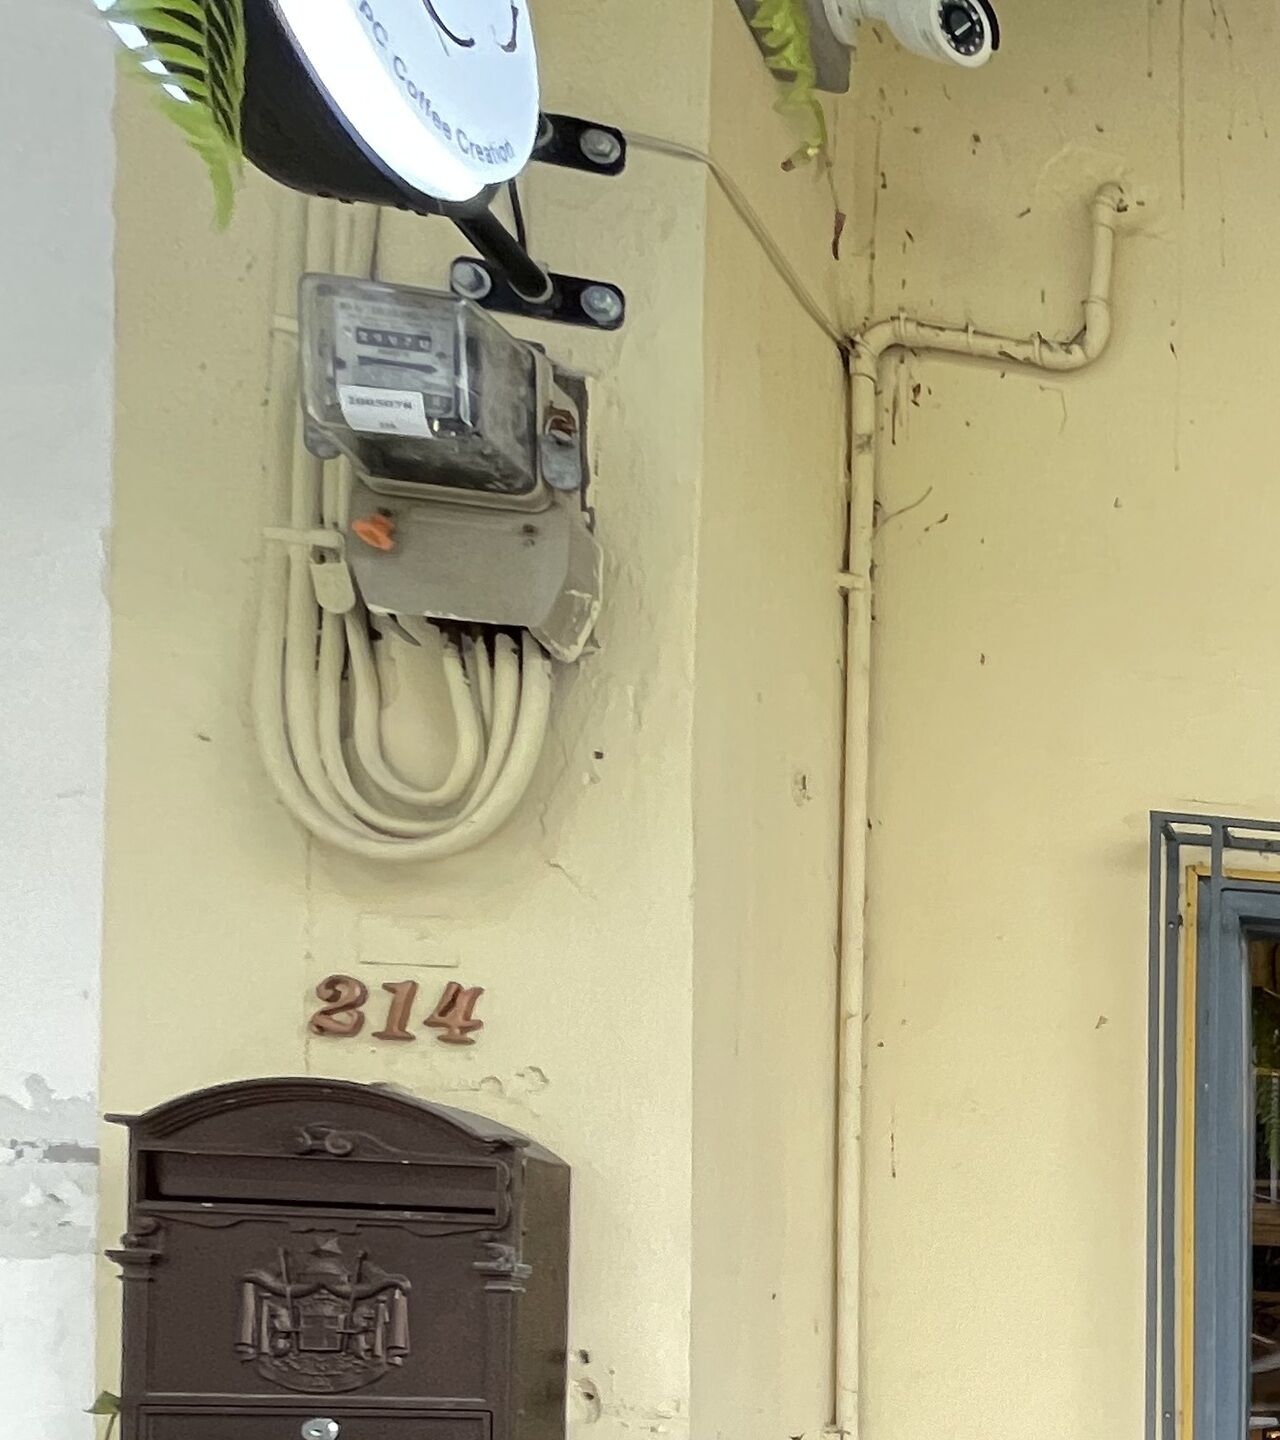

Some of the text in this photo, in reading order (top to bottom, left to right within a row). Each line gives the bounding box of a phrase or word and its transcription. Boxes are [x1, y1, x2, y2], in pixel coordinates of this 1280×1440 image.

[393, 55, 452, 141] Coffee
[456, 127, 516, 165] Creation
[308, 973, 486, 1046] 214
